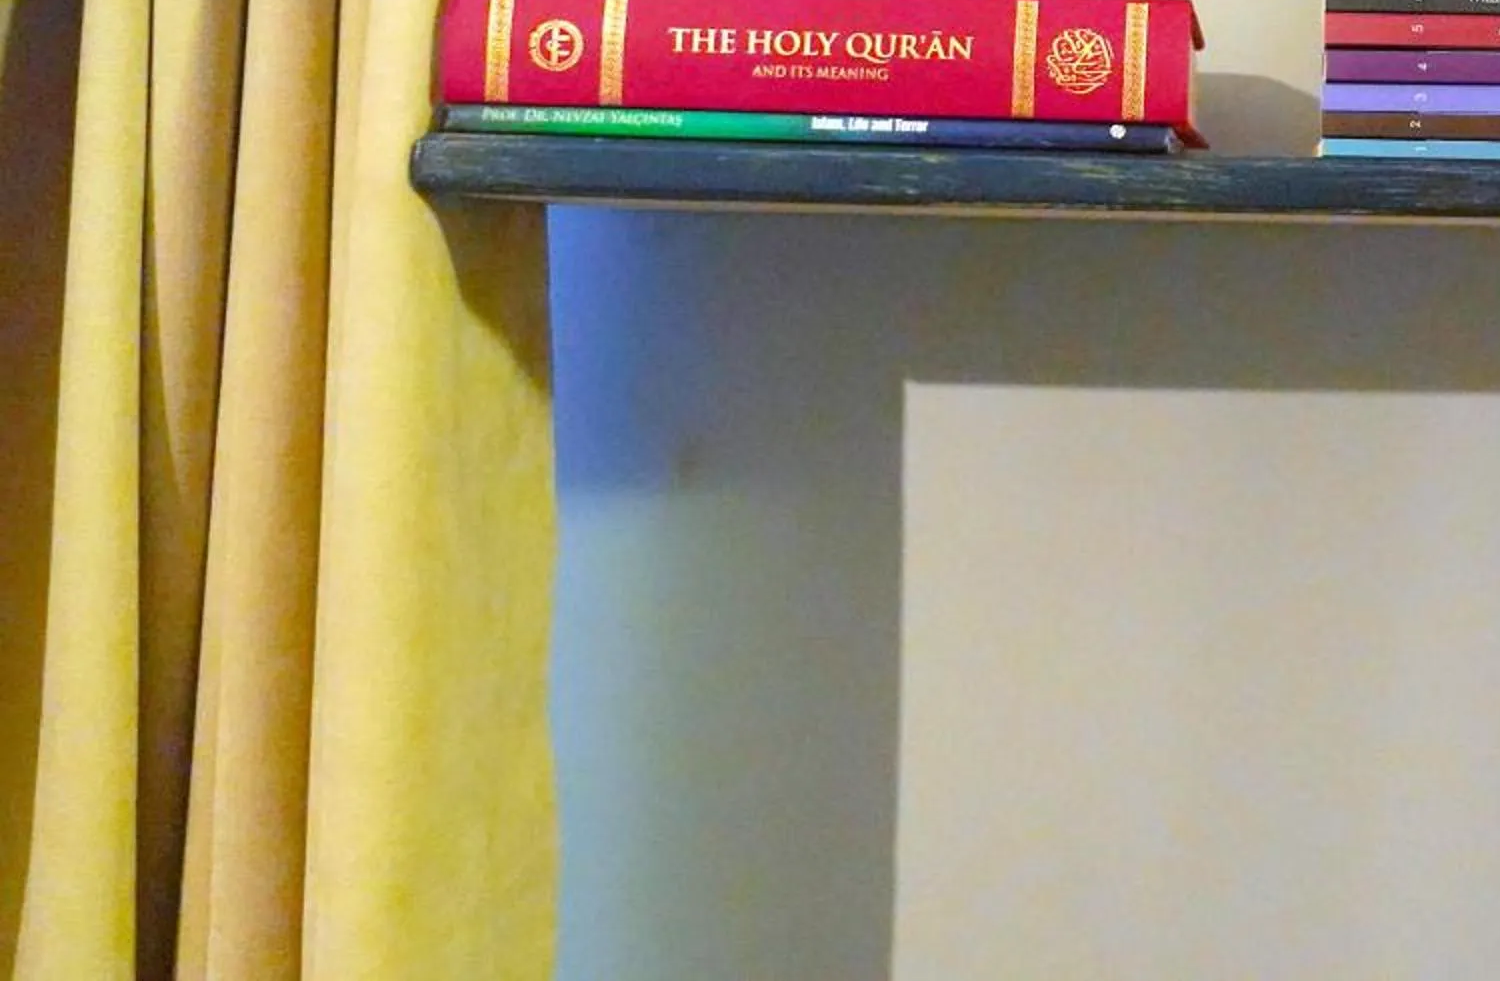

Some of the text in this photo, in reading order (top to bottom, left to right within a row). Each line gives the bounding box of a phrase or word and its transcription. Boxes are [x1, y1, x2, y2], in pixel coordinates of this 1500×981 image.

[668, 27, 736, 54] THE
[748, 29, 841, 56] HOLY
[752, 64, 889, 81] AND ITS MEANING
[870, 118, 892, 132] and
[895, 118, 929, 132] Terror
